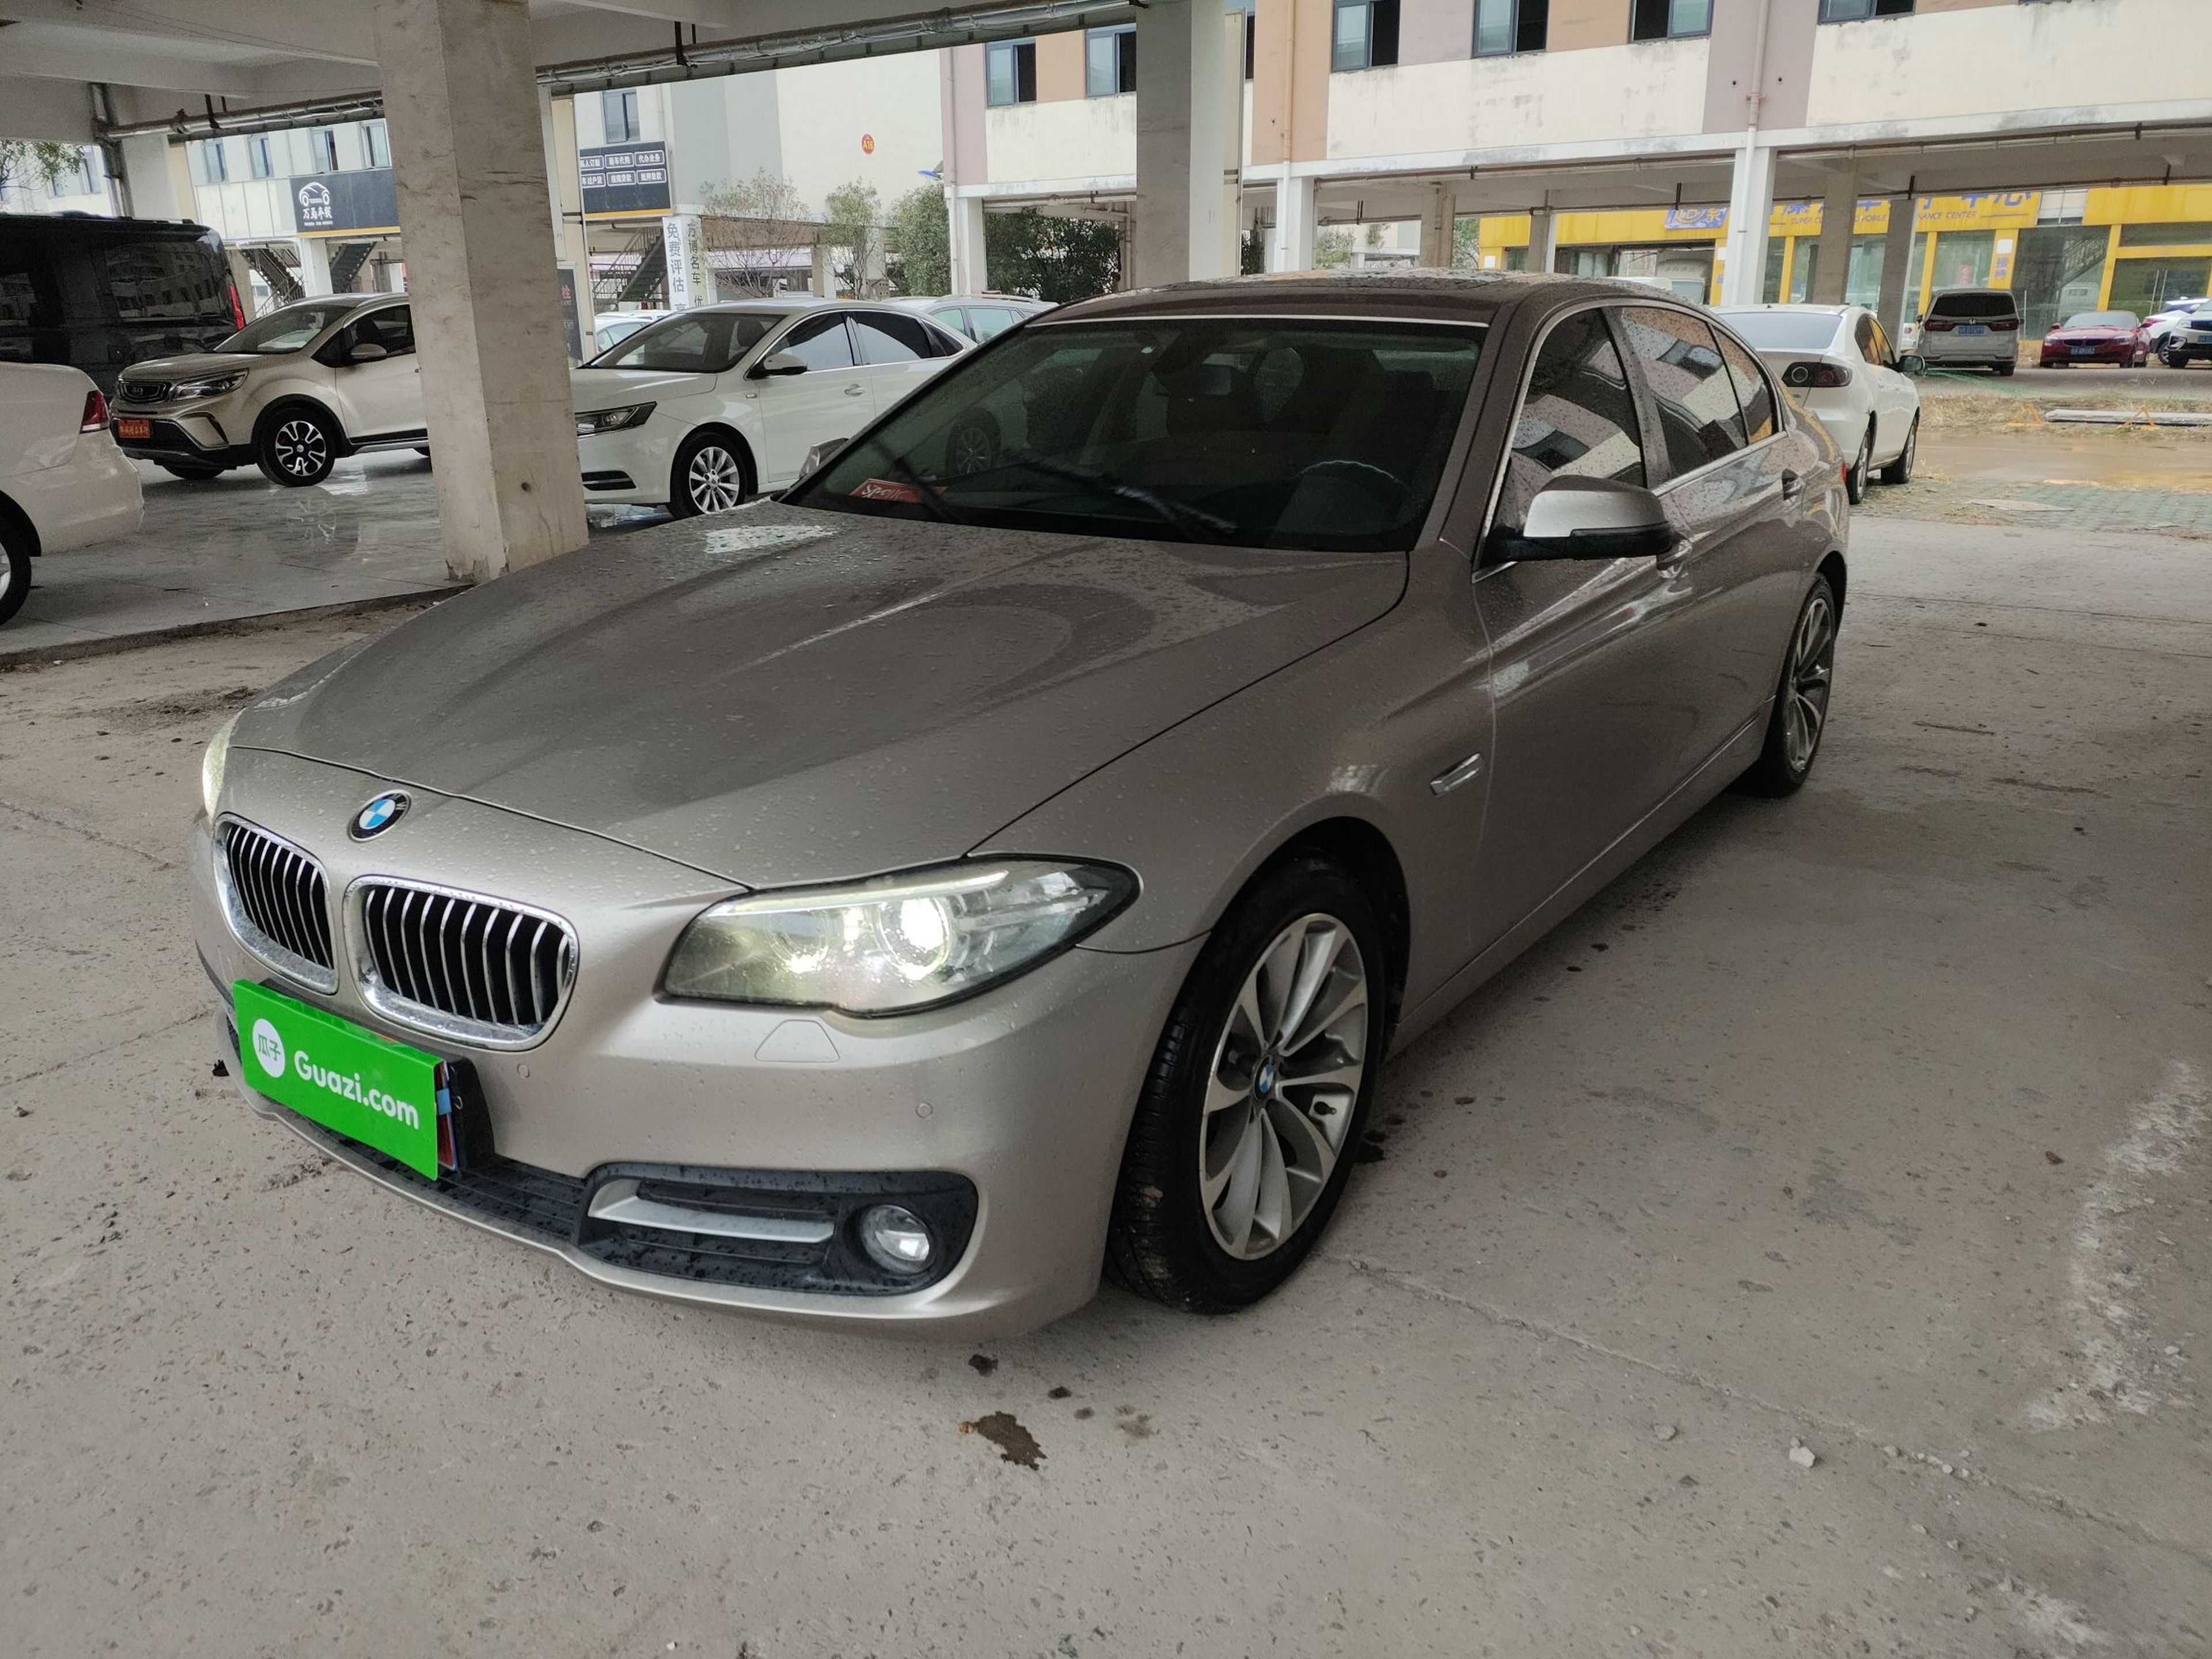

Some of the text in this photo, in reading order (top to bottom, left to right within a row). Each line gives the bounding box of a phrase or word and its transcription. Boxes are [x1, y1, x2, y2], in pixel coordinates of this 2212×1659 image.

[666, 222, 684, 293] 免费评估
[258, 1034, 281, 1062] 瓜子
[294, 1050, 419, 1130] Guazi.com
